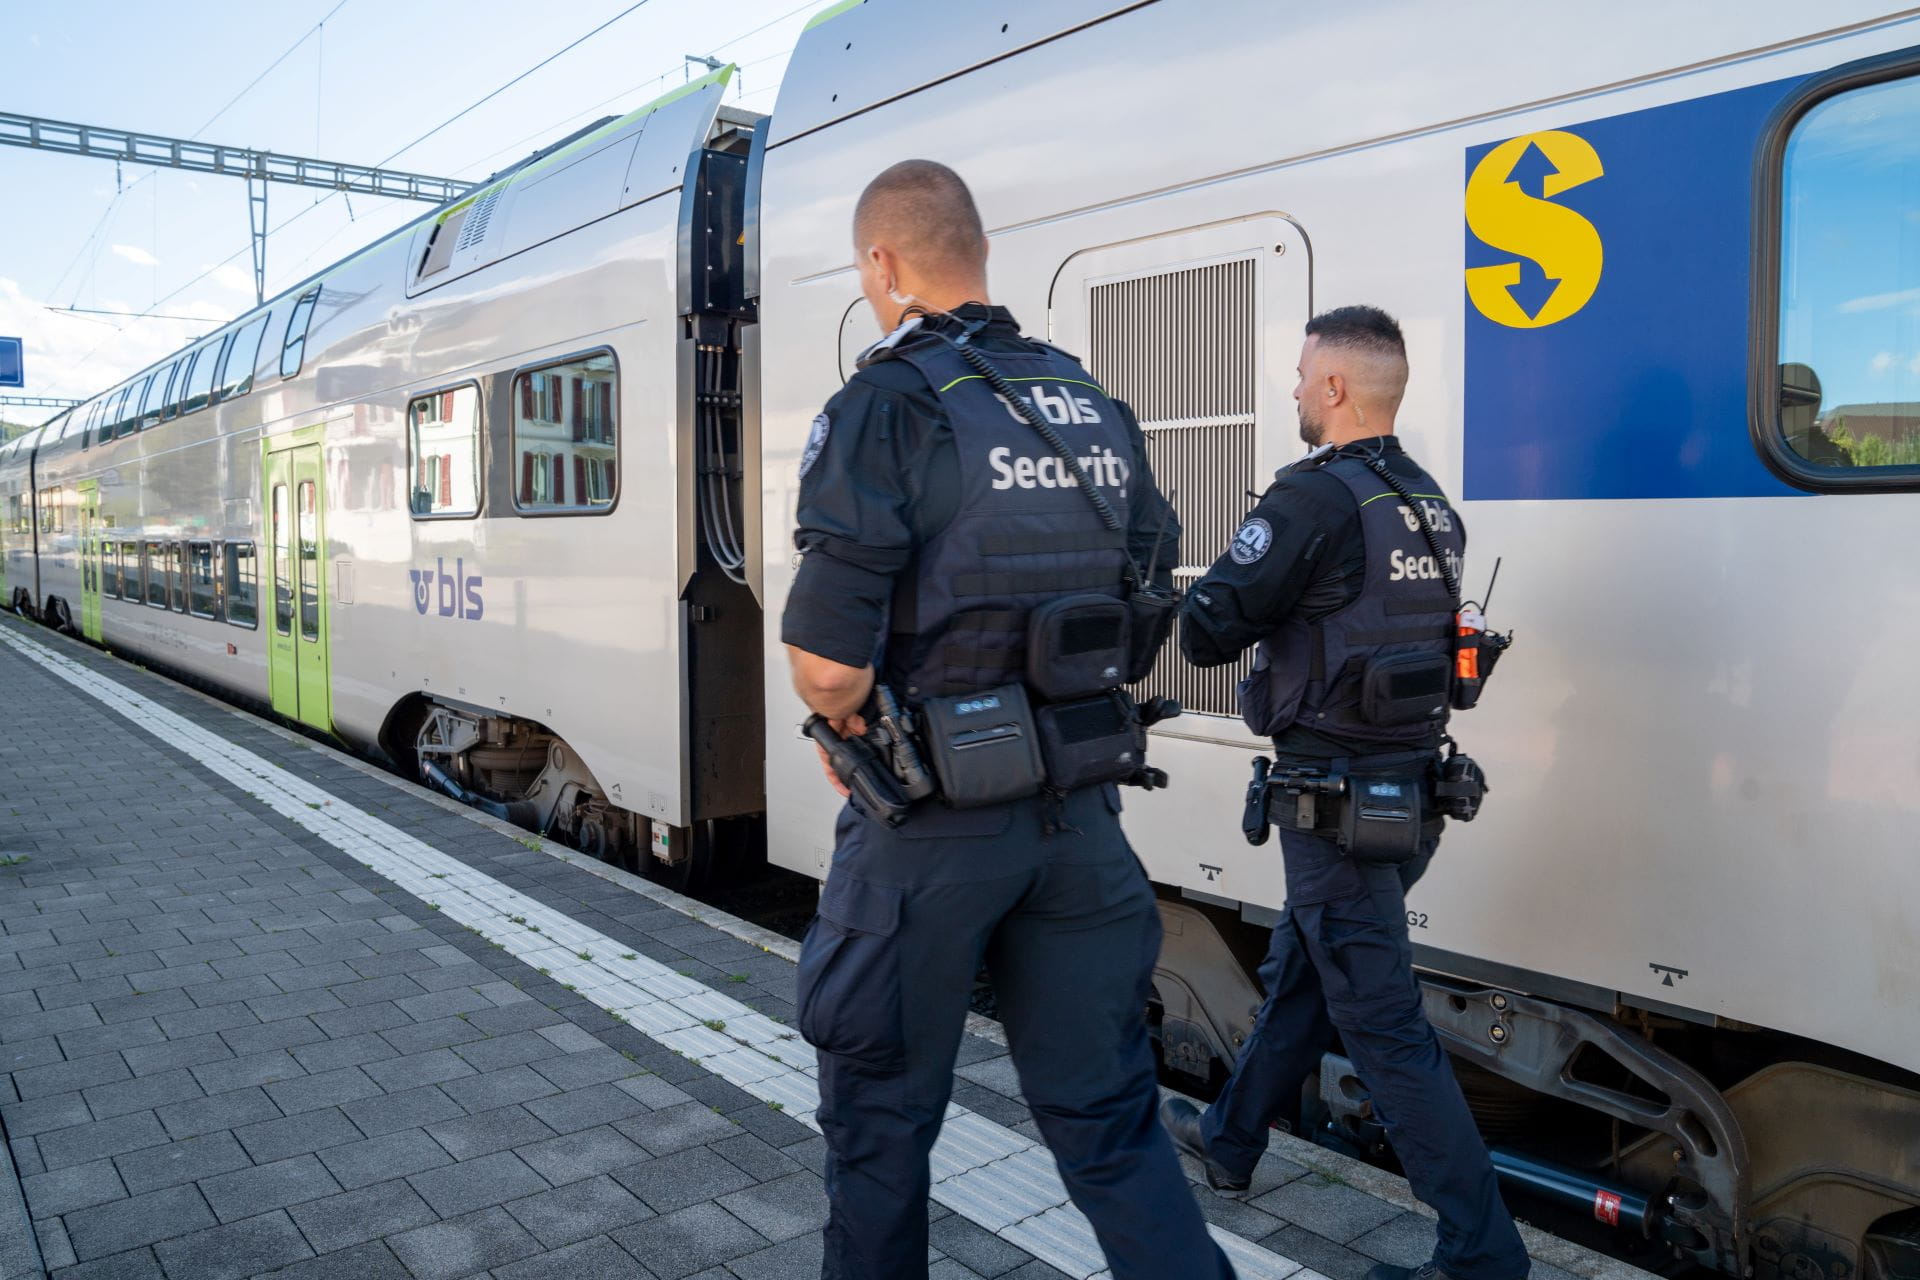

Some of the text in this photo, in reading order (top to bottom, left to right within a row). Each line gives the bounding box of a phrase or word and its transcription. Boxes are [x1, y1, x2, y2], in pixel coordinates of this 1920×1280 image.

[1465, 130, 1604, 329] S
[1031, 386, 1102, 425] bls
[1389, 549, 1464, 587] Secuity
[437, 557, 484, 621] bls
[1406, 910, 1428, 929] G2
